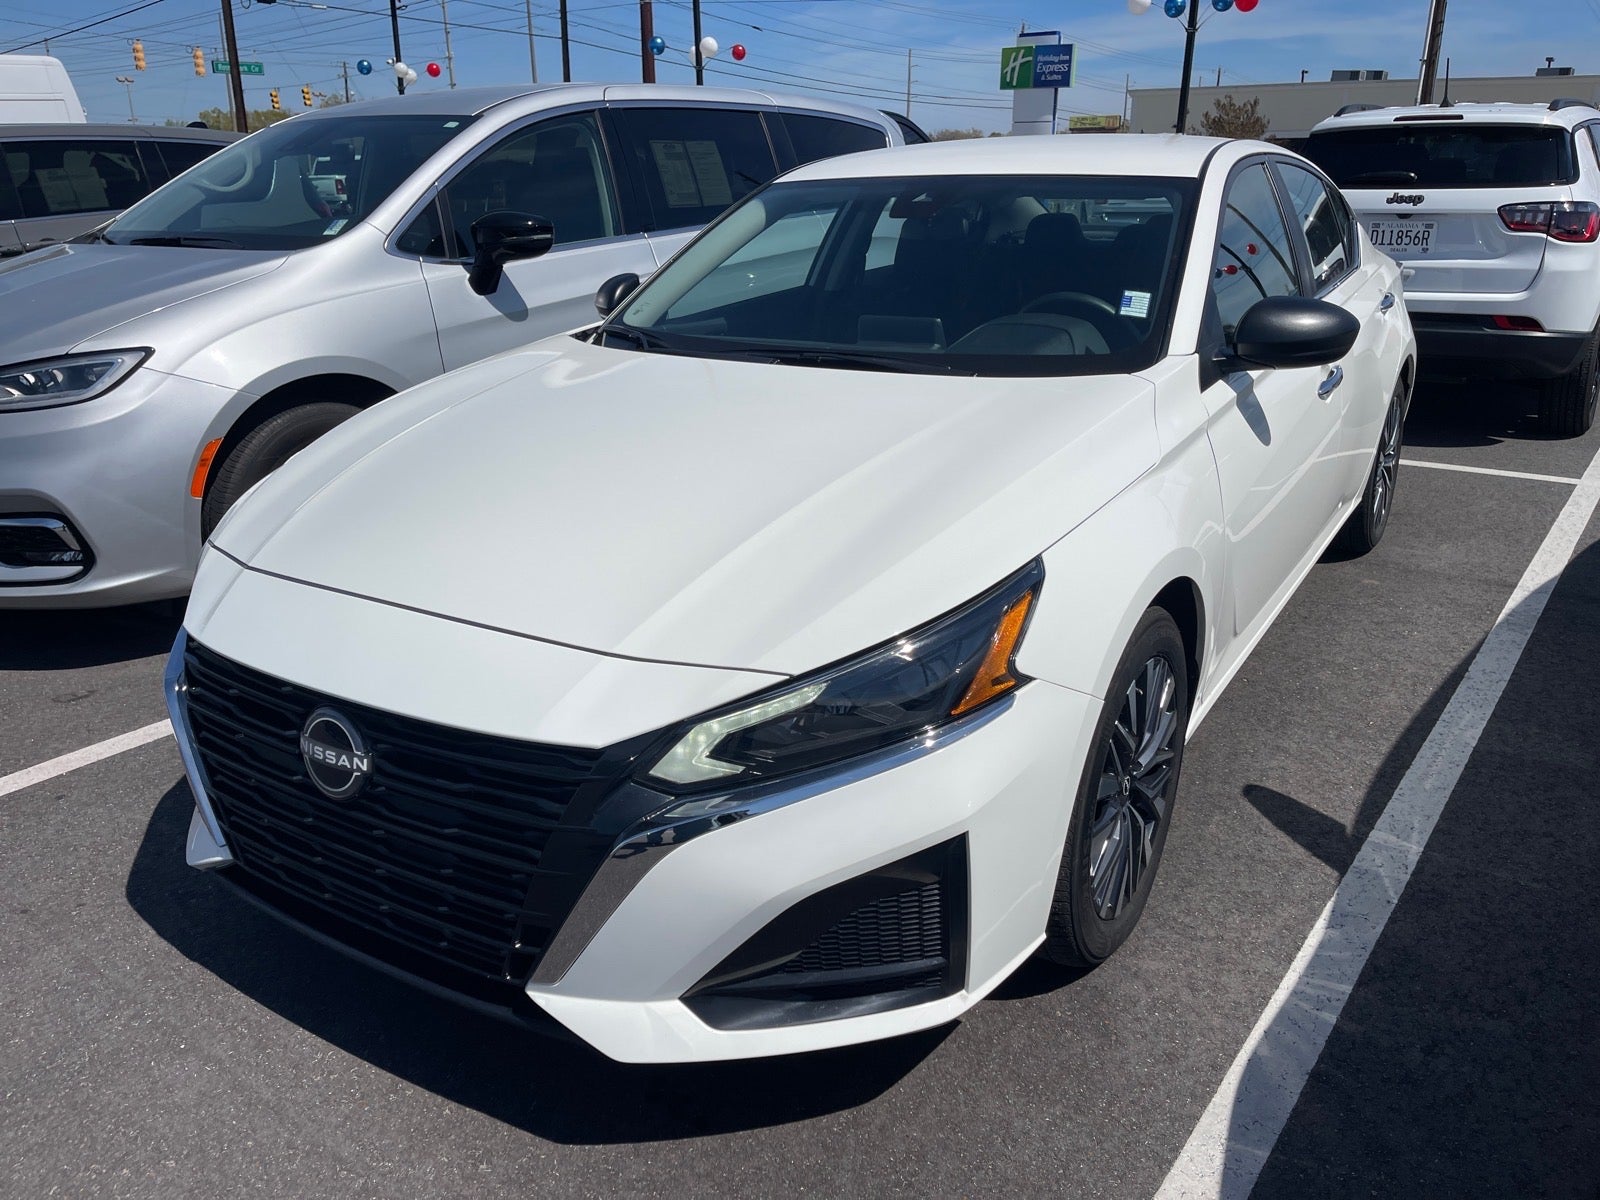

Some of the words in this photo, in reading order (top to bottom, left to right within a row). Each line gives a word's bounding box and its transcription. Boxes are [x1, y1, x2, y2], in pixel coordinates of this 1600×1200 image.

[1037, 54, 1059, 63] Holiday
[1060, 53, 1070, 61] Inn
[1036, 62, 1070, 75] Express
[1385, 192, 1425, 207] Jeep
[1370, 229, 1430, 247] D11856R
[300, 737, 368, 772] NISSAN
